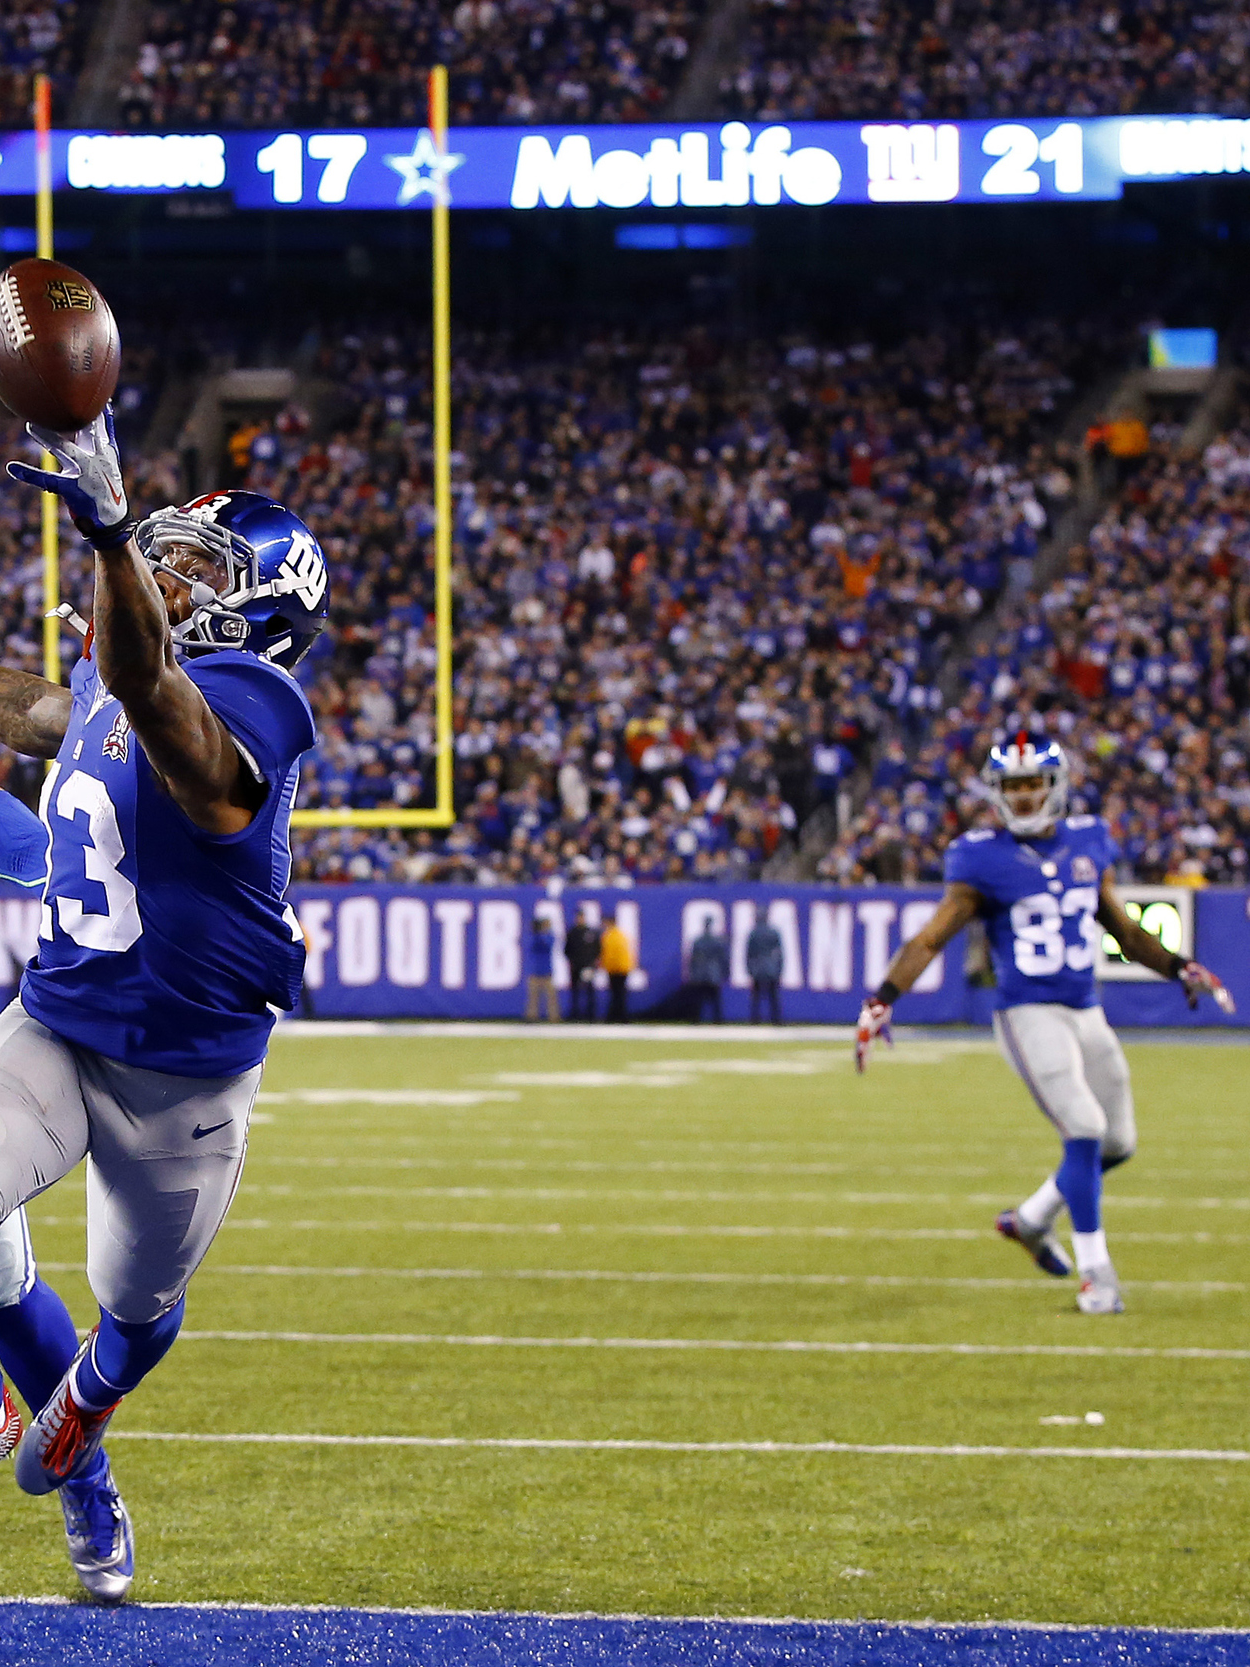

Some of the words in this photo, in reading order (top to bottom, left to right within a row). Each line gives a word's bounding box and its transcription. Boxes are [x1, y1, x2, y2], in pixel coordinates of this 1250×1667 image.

[257, 134, 367, 203] 17
[511, 121, 842, 208] MetLife
[981, 123, 1084, 195] 21
[1010, 891, 1098, 977] 83
